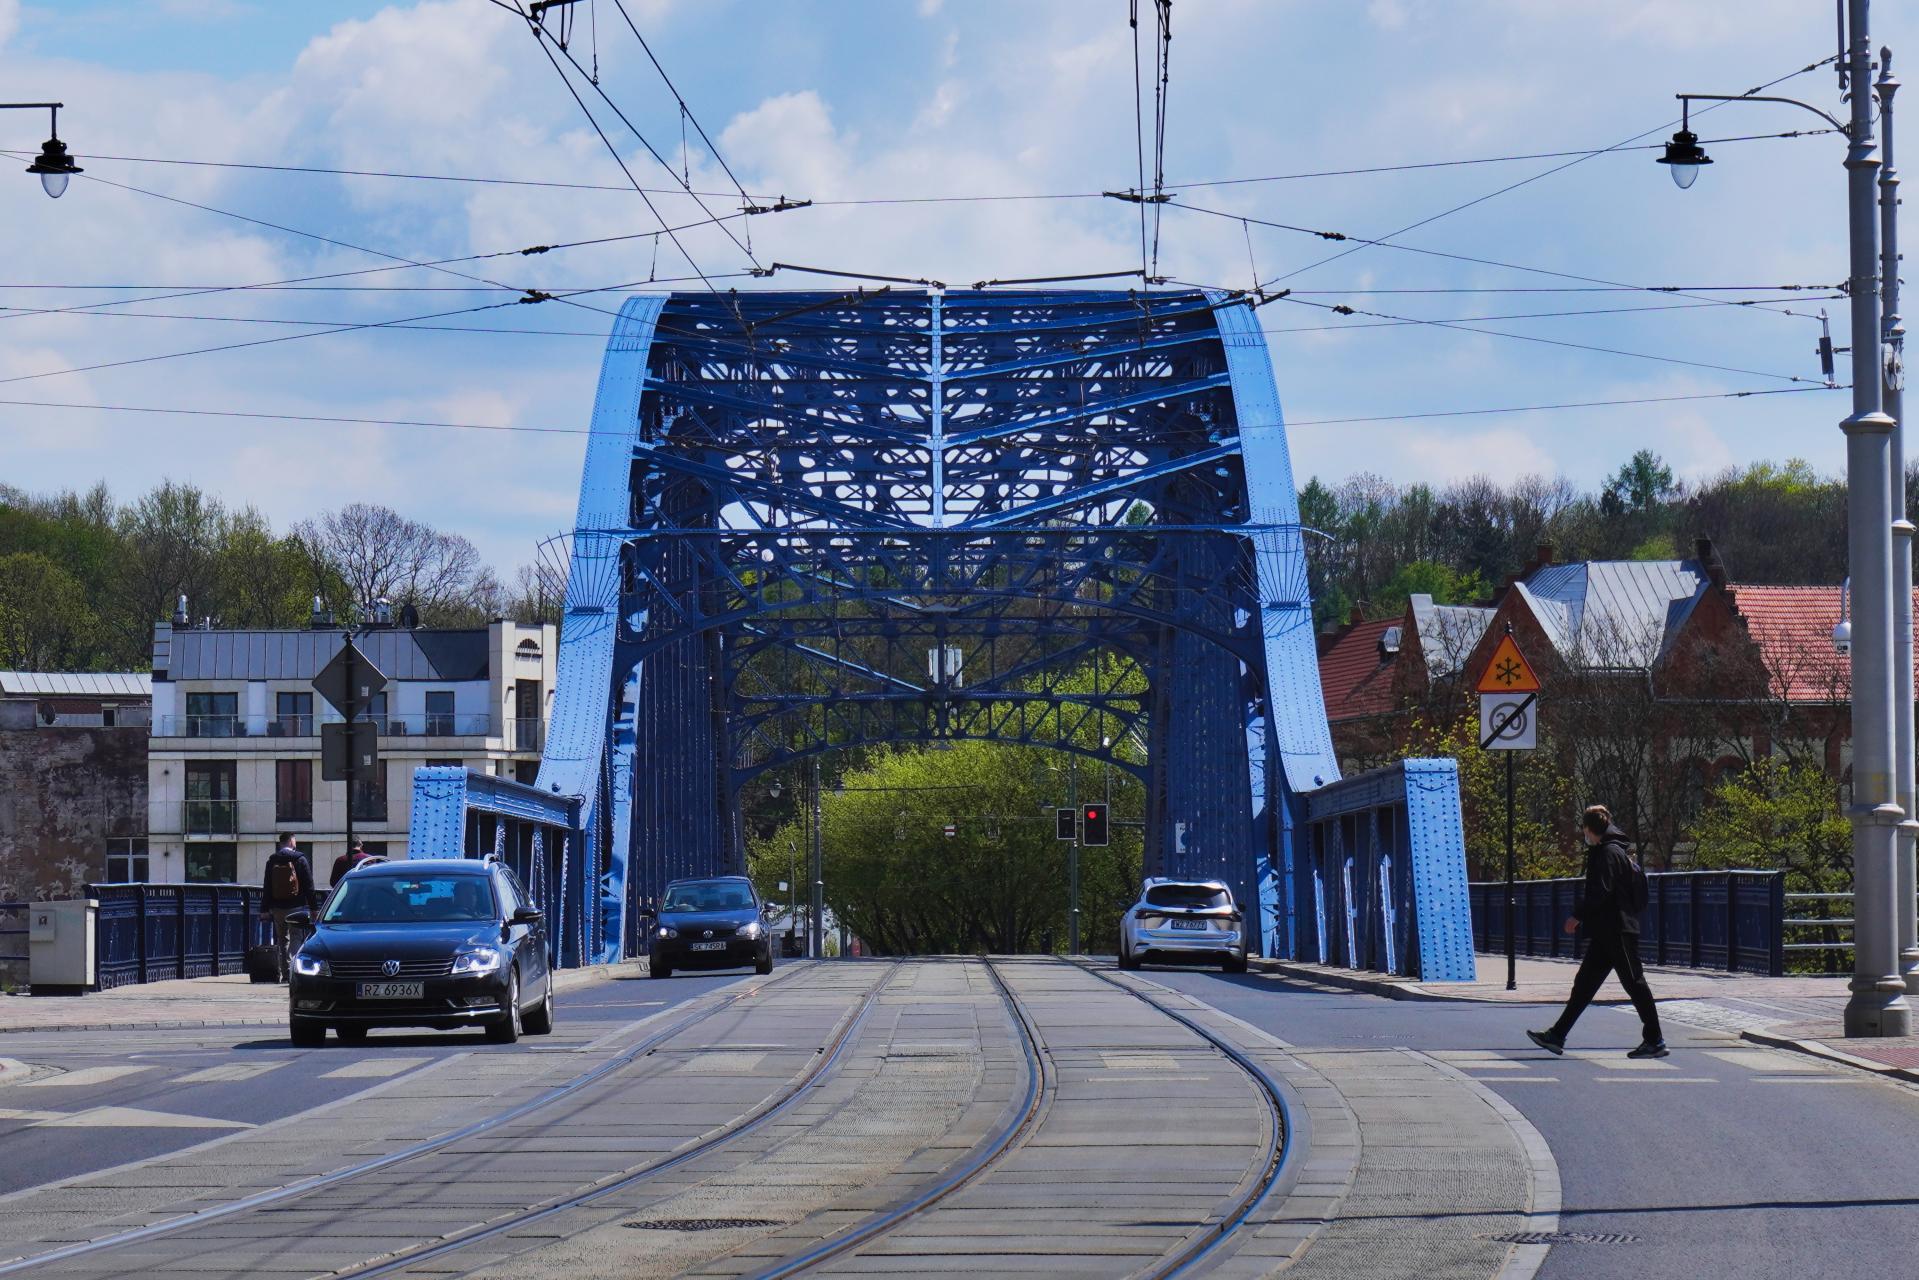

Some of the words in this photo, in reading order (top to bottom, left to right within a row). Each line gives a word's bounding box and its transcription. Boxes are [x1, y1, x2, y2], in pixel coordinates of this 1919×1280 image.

[1495, 712, 1522, 731] 30
[364, 984, 380, 996] RZ
[384, 983, 420, 996] 6936X
